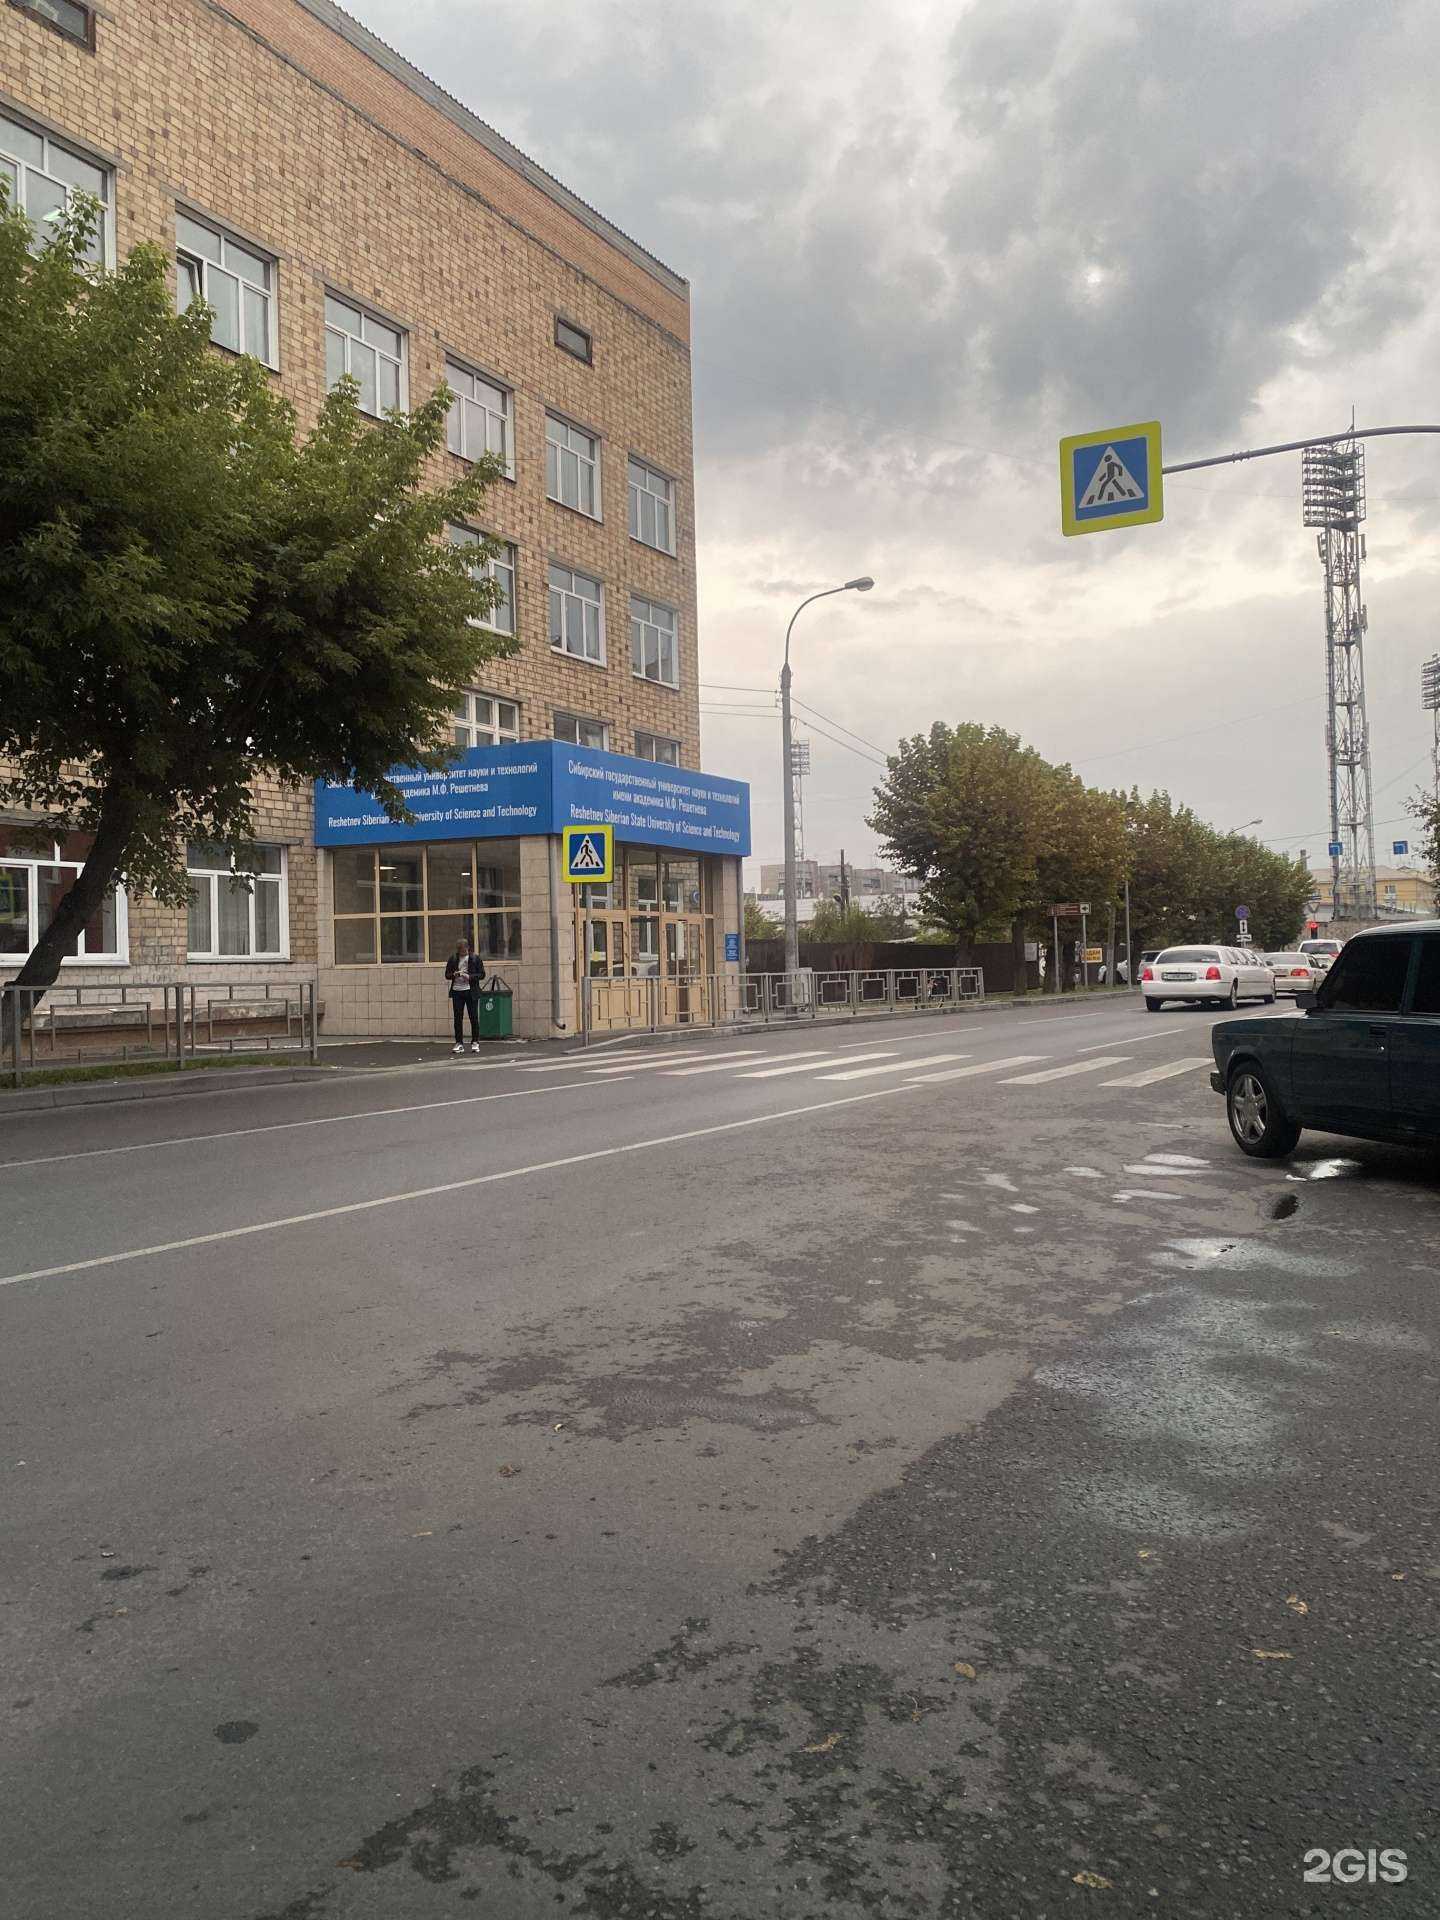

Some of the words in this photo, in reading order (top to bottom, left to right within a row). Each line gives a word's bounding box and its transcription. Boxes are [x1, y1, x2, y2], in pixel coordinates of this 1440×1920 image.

[467, 768, 489, 779] науки
[490, 767, 496, 776] и
[497, 762, 538, 775] технологий
[568, 759, 604, 780] Сибирский
[605, 770, 656, 789] государственный
[658, 780, 691, 796] университет
[401, 788, 431, 799] адемика
[432, 783, 449, 796] М.Ф.
[450, 782, 489, 794] Решетнева
[612, 790, 632, 802] имени
[633, 793, 665, 808] академика
[679, 798, 707, 816] Решетнева
[328, 815, 361, 828] Reshetnev
[362, 814, 390, 825] Siberian
[415, 810, 443, 822] niversity
[445, 810, 453, 820] of
[453, 806, 481, 819] Science
[482, 805, 496, 817] and
[497, 804, 537, 817] Technology
[570, 803, 604, 821] Reshetnev
[604, 808, 630, 825] Siberian
[630, 812, 646, 827] State
[647, 815, 675, 834] University
[675, 820, 682, 833] of
[682, 820, 702, 836] Science
[702, 825, 714, 838] and
[712, 825, 740, 843] Technology
